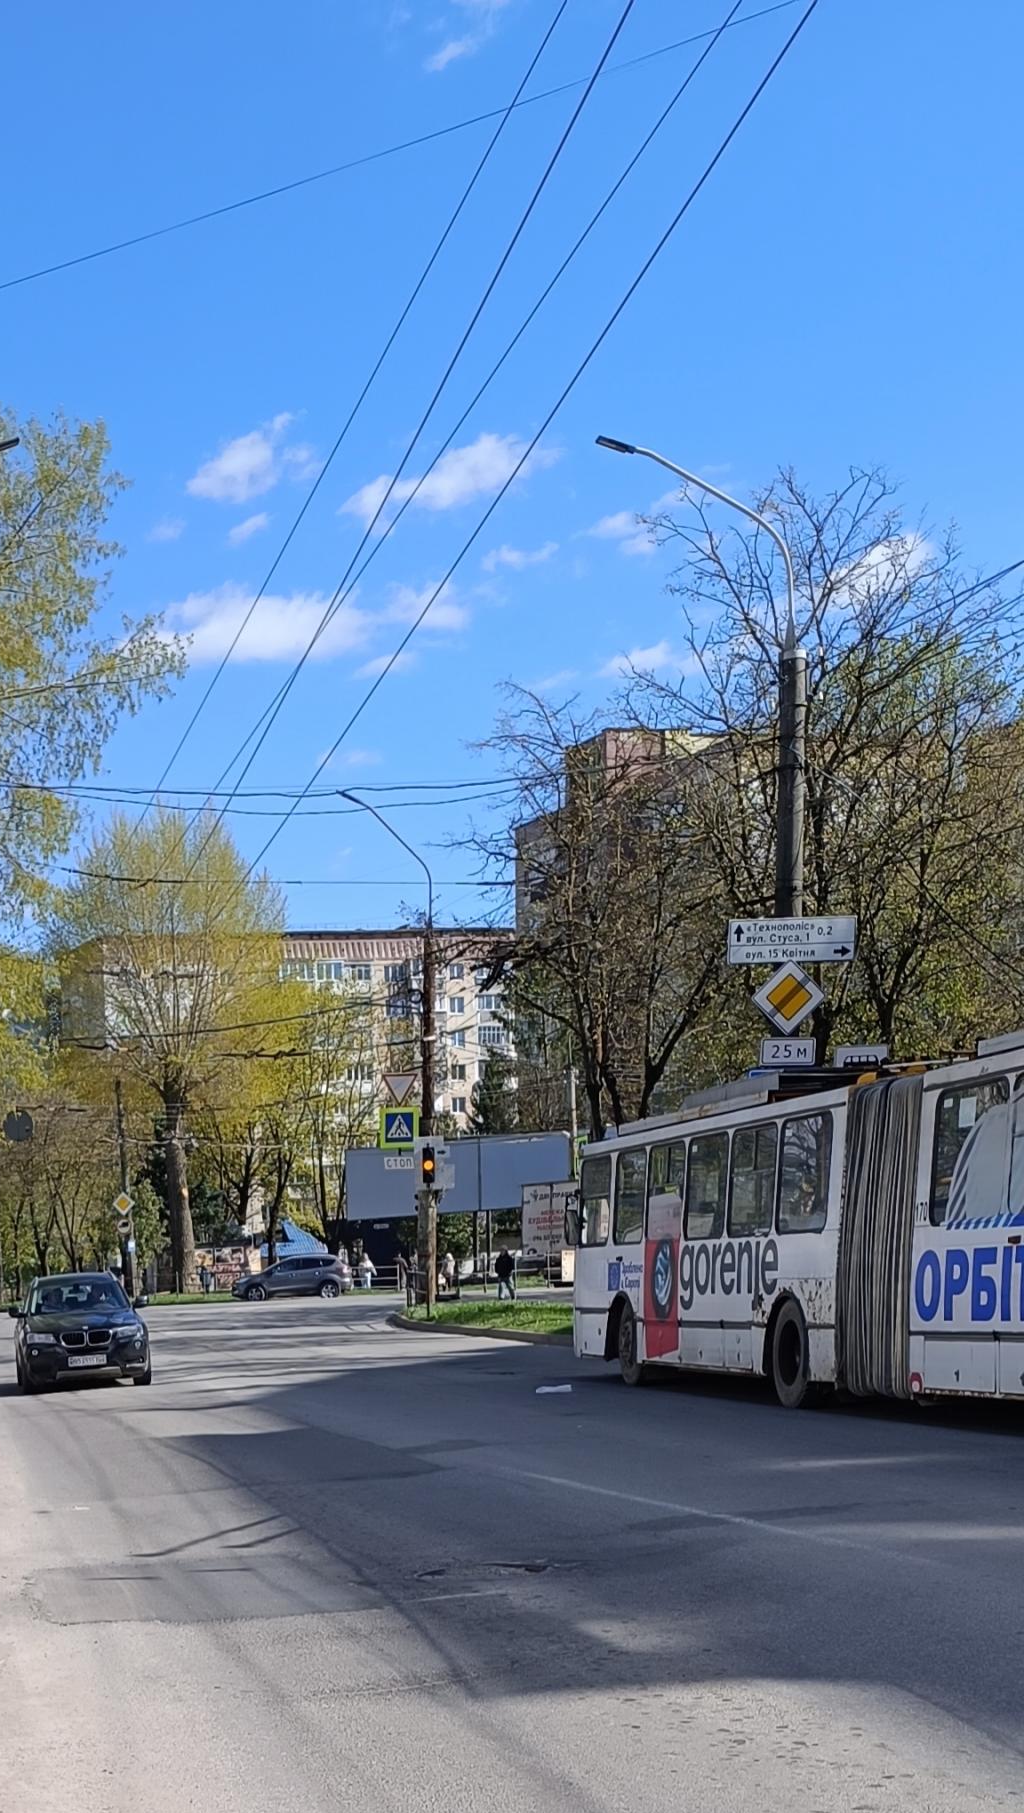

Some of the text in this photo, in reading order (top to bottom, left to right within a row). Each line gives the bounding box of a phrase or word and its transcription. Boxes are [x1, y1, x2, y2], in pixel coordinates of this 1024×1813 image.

[746, 920, 815, 933] «Технополіс»
[817, 925, 833, 937] 0,2
[745, 936, 766, 946] вул.
[745, 947, 816, 960] вул. 15 Квітня
[771, 1044, 792, 1059] 25
[386, 1158, 413, 1168] СТОП
[679, 1238, 779, 1312] gorenje
